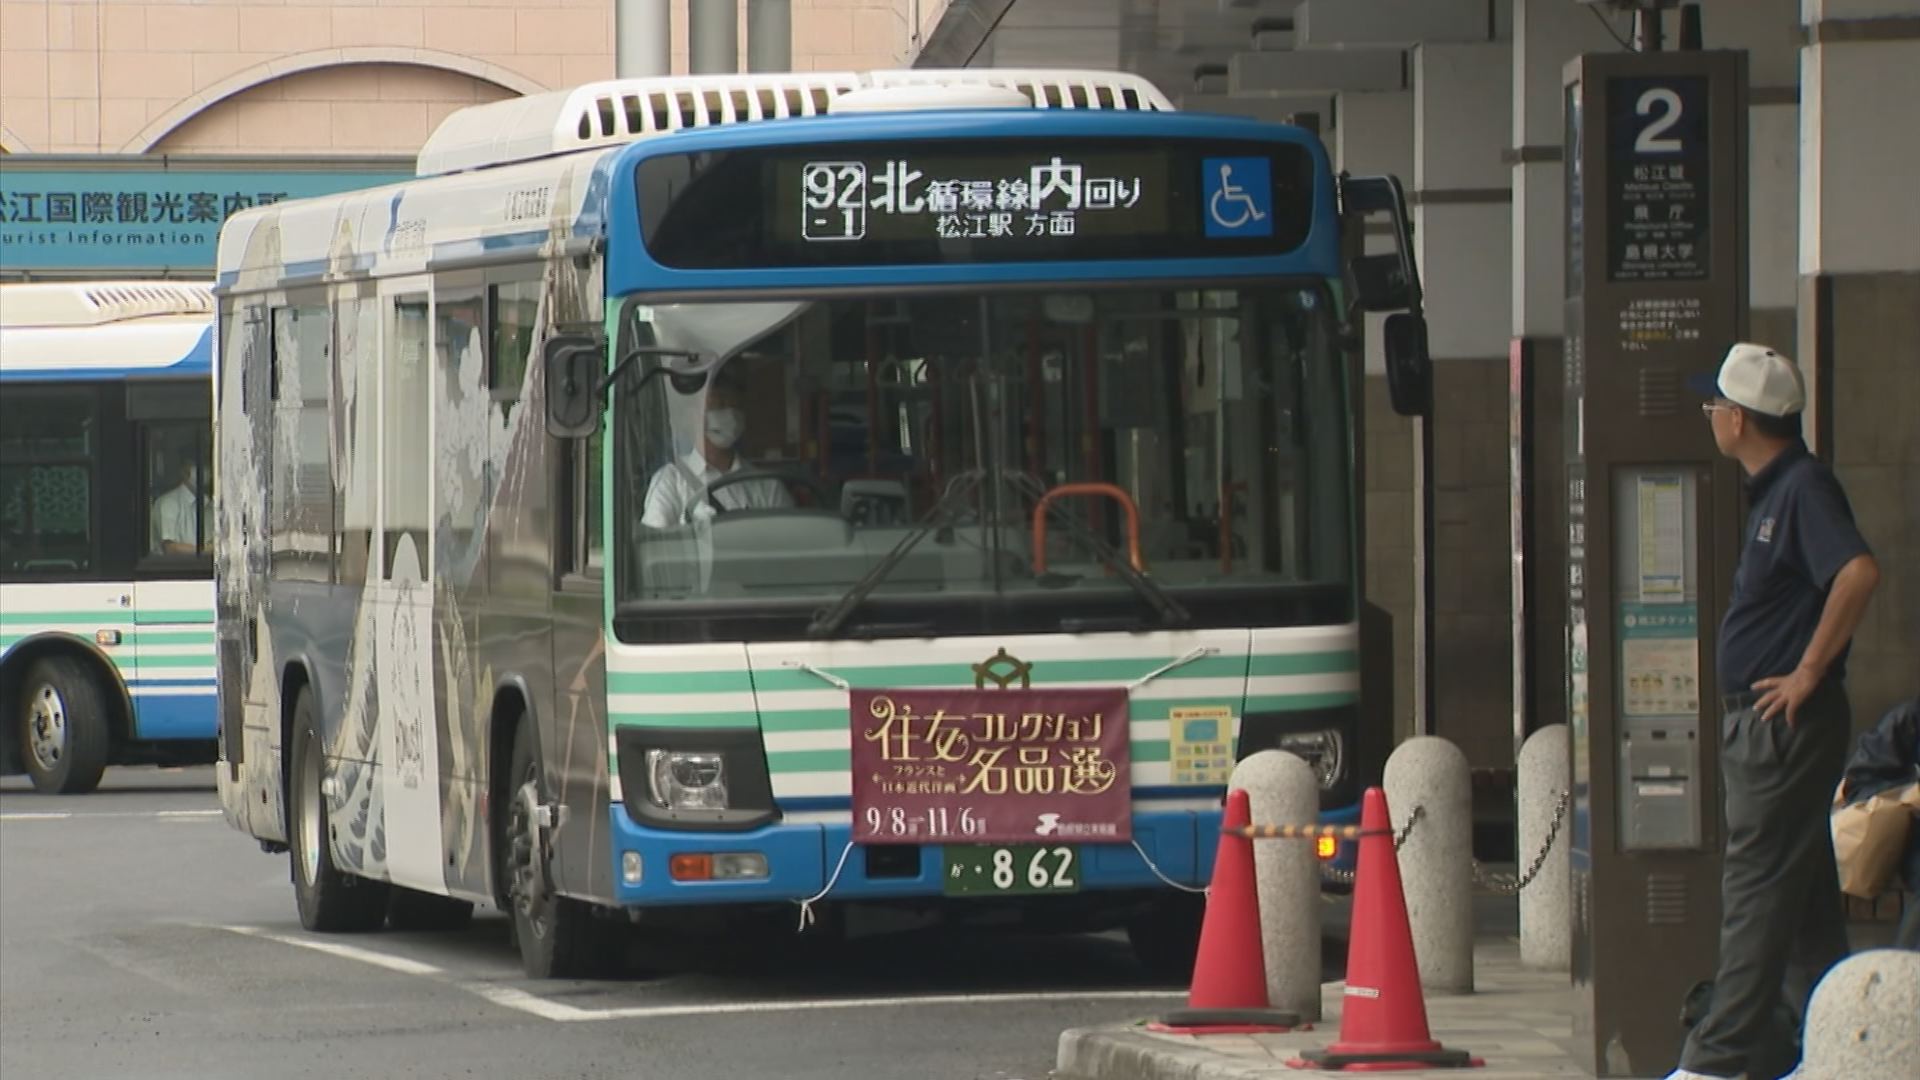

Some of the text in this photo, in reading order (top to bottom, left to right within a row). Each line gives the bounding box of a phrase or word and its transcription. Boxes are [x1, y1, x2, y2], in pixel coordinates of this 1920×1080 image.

[1634, 87, 1684, 152] 2
[806, 165, 863, 208] 92
[870, 156, 1140, 214] 北循環線内回り
[68, 229, 205, 246] Information
[936, 211, 1075, 239] 松江駅 方面
[865, 696, 1101, 761] 住友 コレクション
[960, 746, 1116, 795] 名品選
